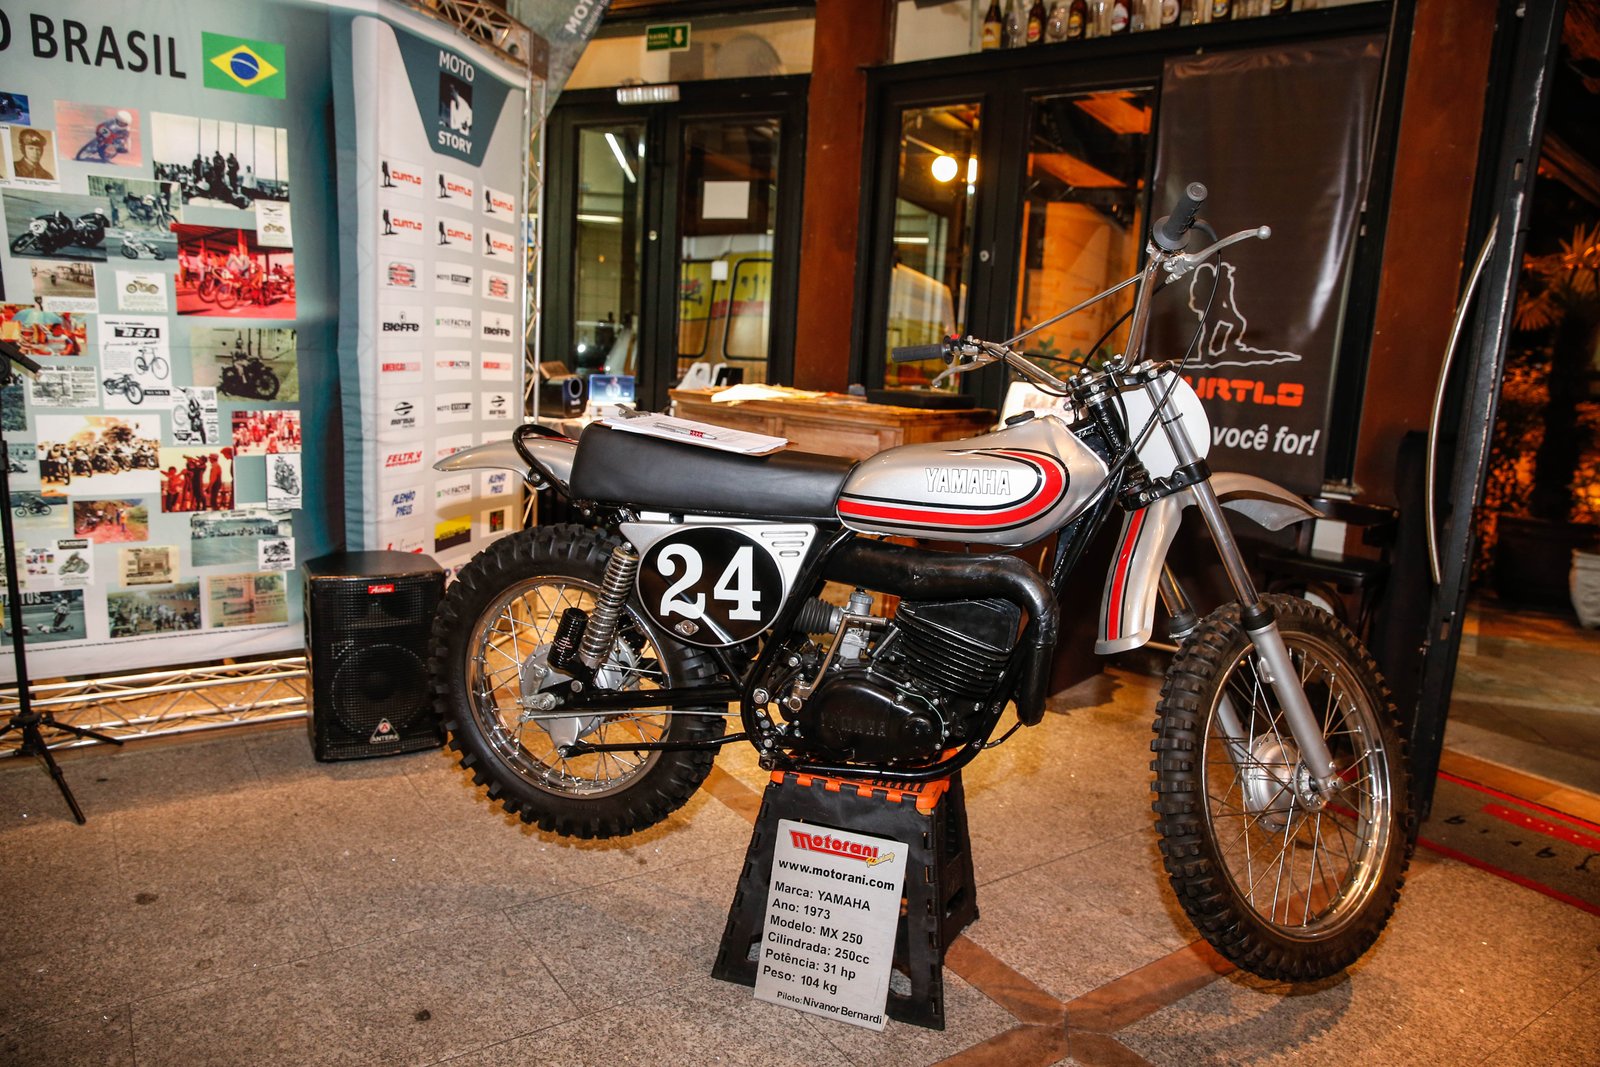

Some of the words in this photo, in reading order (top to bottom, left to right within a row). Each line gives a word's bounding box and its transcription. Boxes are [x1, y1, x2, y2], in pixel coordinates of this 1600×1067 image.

[29, 12, 187, 80] BRASIL
[438, 50, 475, 82] MOTO
[437, 130, 473, 155] STORY
[392, 170, 422, 185] CURTLO
[447, 182, 472, 197] CURTLO
[392, 218, 422, 231] CURTLO
[447, 229, 472, 241] CURTLO
[121, 328, 157, 338] BSA
[1181, 376, 1305, 407] URTLO
[1212, 424, 1269, 451] você
[1272, 426, 1321, 456] for!
[925, 467, 1011, 496] YAMAHA
[656, 543, 762, 621] 24
[778, 860, 895, 891] www.motorani.com
[772, 898, 799, 913] Ano:
[803, 905, 831, 920] 1973
[774, 881, 813, 898] Marca:
[817, 890, 871, 911] YAMAHA
[770, 915, 816, 934] Modelo:
[820, 926, 839, 940] MX
[842, 931, 863, 945] 250
[768, 931, 831, 956] Cilindrada:
[834, 947, 870, 965] 250cc
[765, 948, 819, 971] Potência:
[823, 962, 837, 974] 31
[840, 966, 856, 980] hp
[763, 965, 795, 982] Peso:
[800, 975, 819, 988] 104
[823, 979, 838, 996] kg
[840, 1006, 883, 1025] Bernardi
